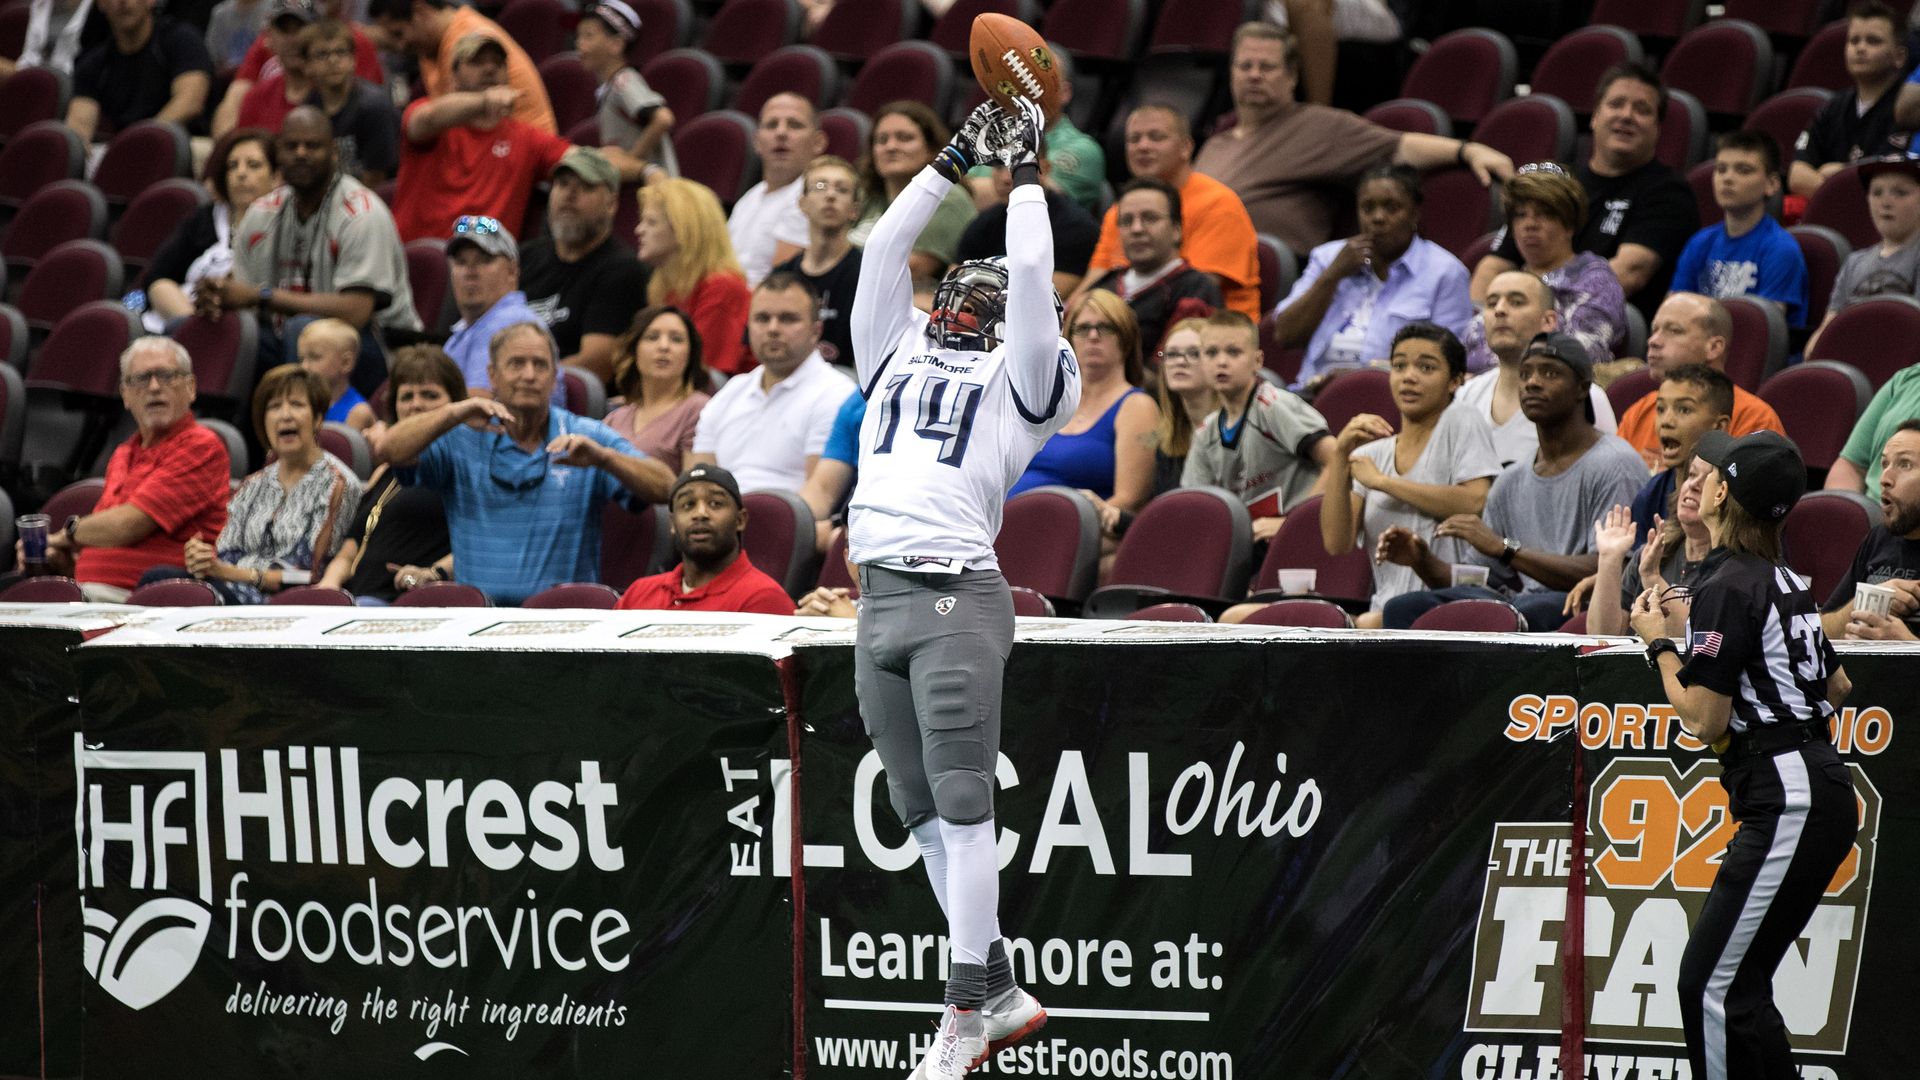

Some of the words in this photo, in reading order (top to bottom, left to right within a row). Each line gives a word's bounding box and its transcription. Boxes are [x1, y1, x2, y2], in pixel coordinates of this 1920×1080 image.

[908, 355, 974, 374] BALTIMORE
[873, 373, 984, 469] 14
[1791, 612, 1827, 682] 37
[220, 746, 625, 872] Hillcrest
[720, 757, 763, 877] EAT
[1166, 740, 1323, 838] Ohio
[1502, 838, 1594, 886] THE
[225, 872, 631, 973] foodservice
[1150, 933, 1223, 991] at:
[226, 980, 348, 1035] delivering
[361, 986, 398, 1024] the
[410, 988, 470, 1039] right
[481, 993, 628, 1042] ingredients
